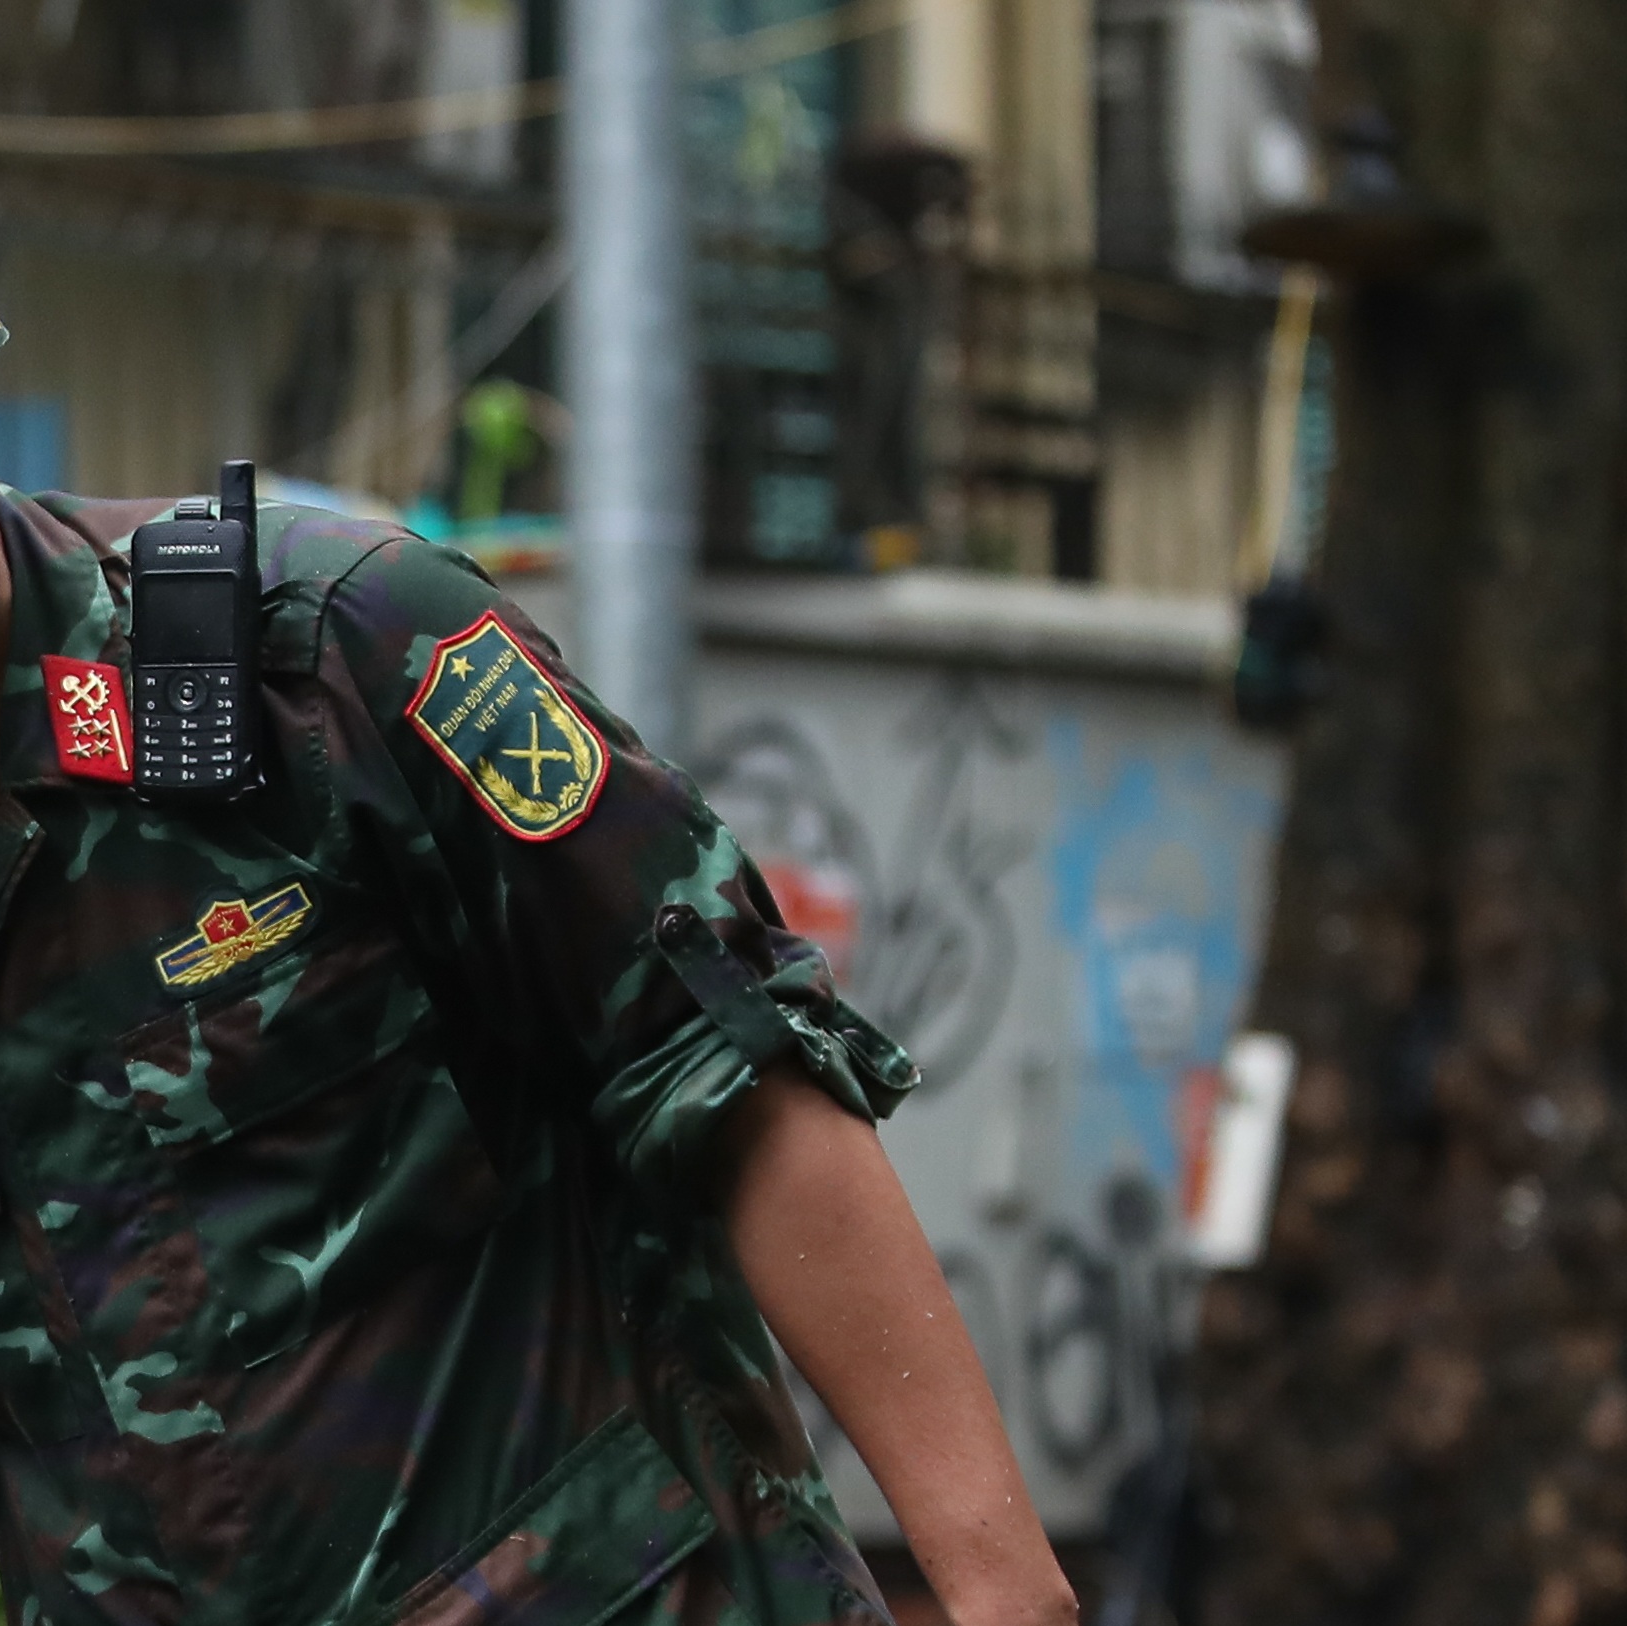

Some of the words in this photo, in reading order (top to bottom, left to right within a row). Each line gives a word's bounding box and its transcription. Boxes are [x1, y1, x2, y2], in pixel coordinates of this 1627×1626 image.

[156, 544, 222, 556] MOTOROLA
[441, 704, 470, 738] QUÂN
[465, 686, 486, 710] ĐỘI
[479, 663, 505, 694] NHÂN
[474, 702, 500, 732] VIỆT
[495, 681, 519, 709] NAM
